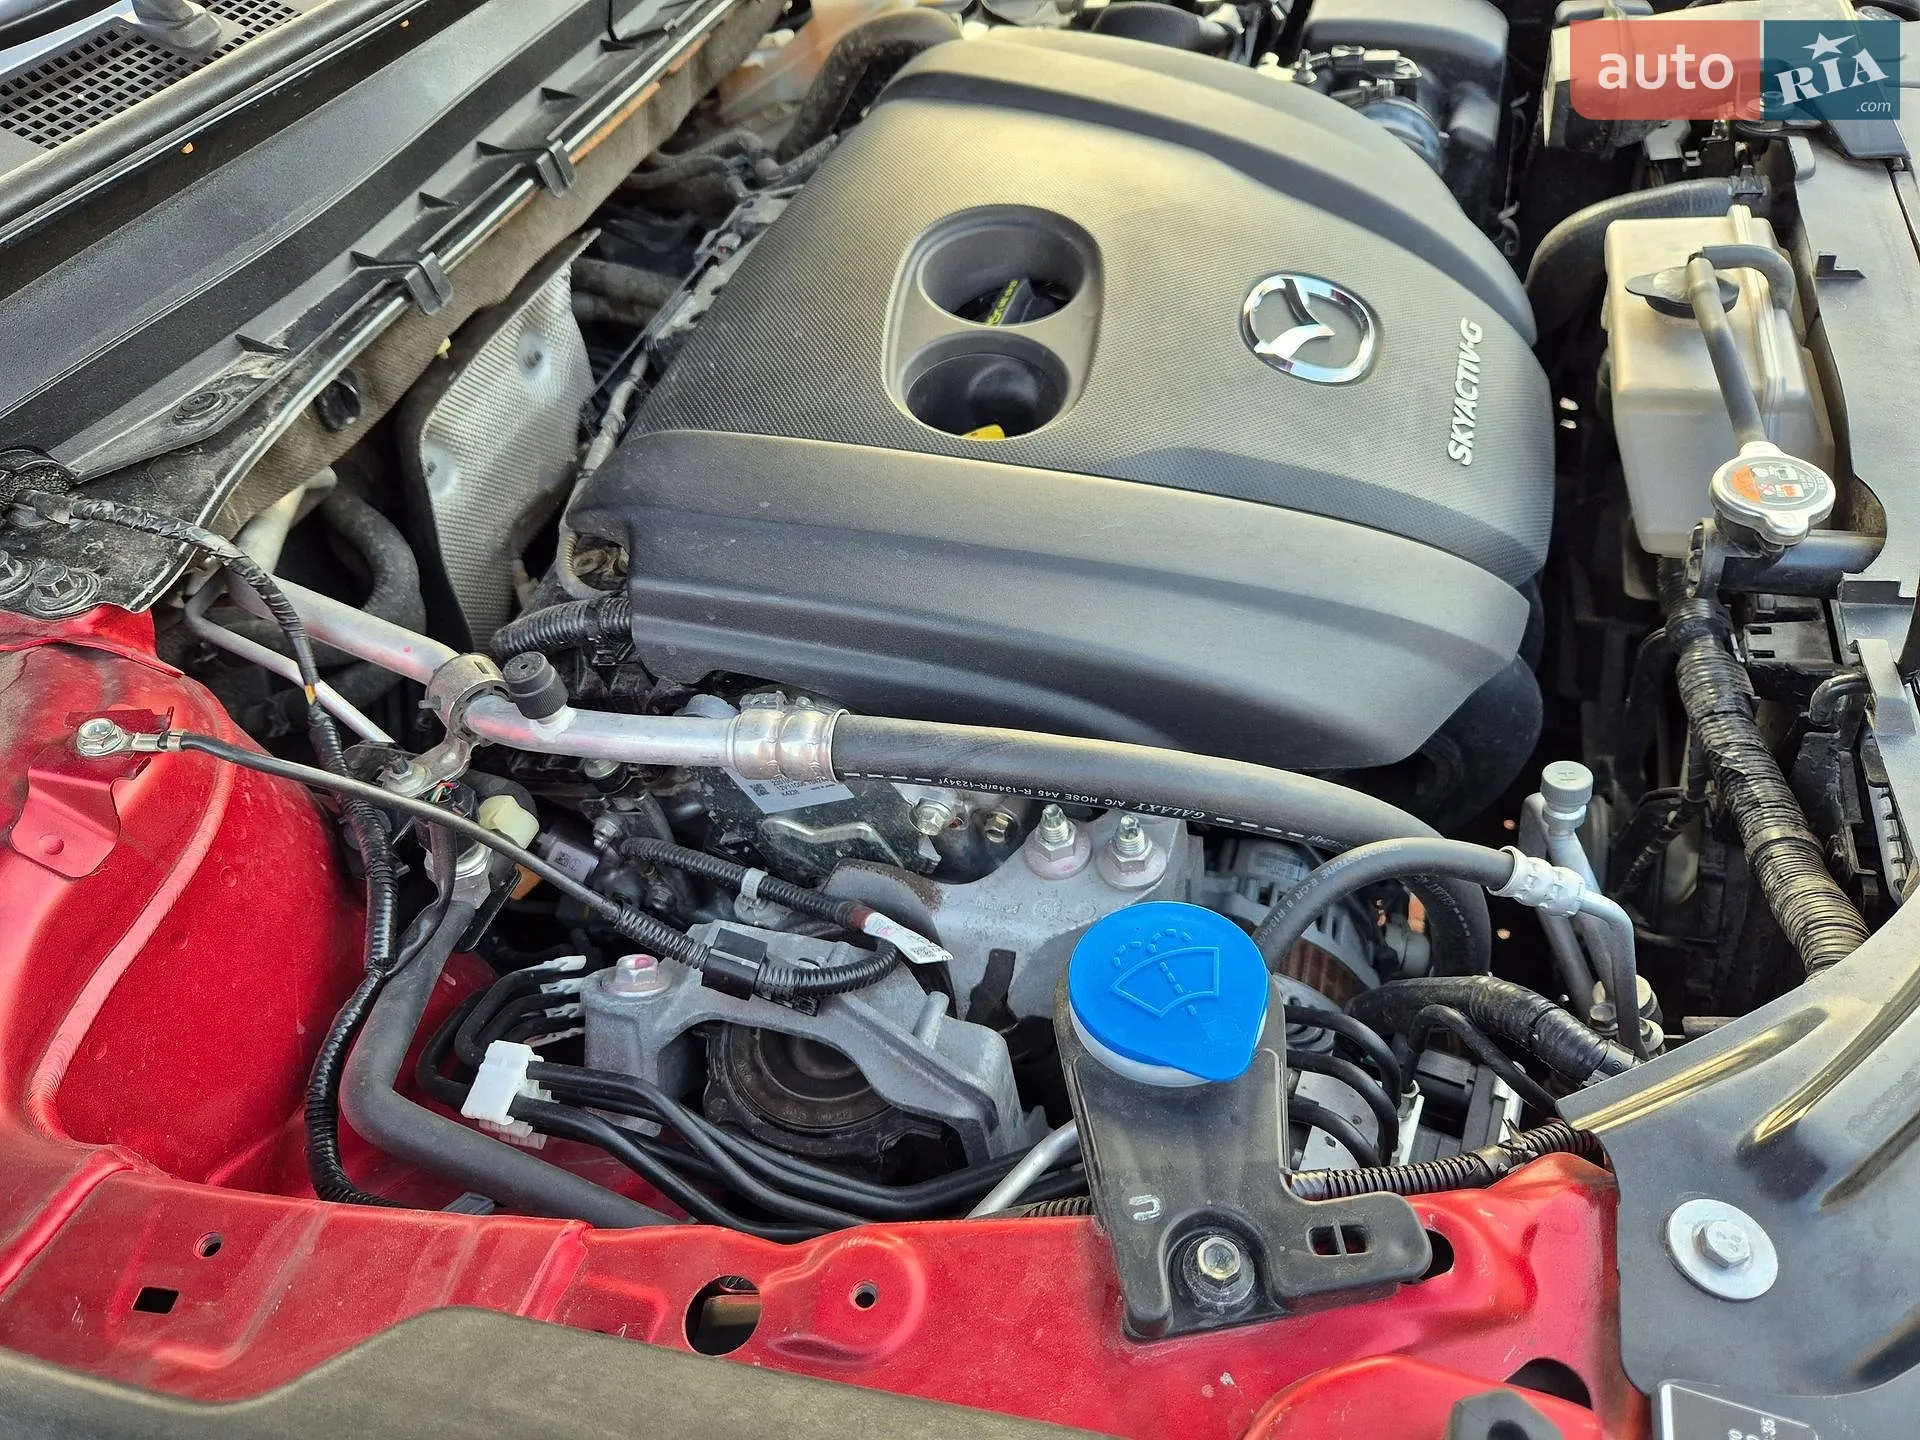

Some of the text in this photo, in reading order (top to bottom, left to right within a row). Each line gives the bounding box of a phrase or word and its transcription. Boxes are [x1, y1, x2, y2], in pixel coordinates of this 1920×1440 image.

[1448, 317, 1483, 466] SKYACTIV-G
[1037, 789, 1060, 799] A45
[1064, 793, 1099, 804] HOSE
[1103, 798, 1126, 808] A/C
[1132, 802, 1207, 820] GALAXY
